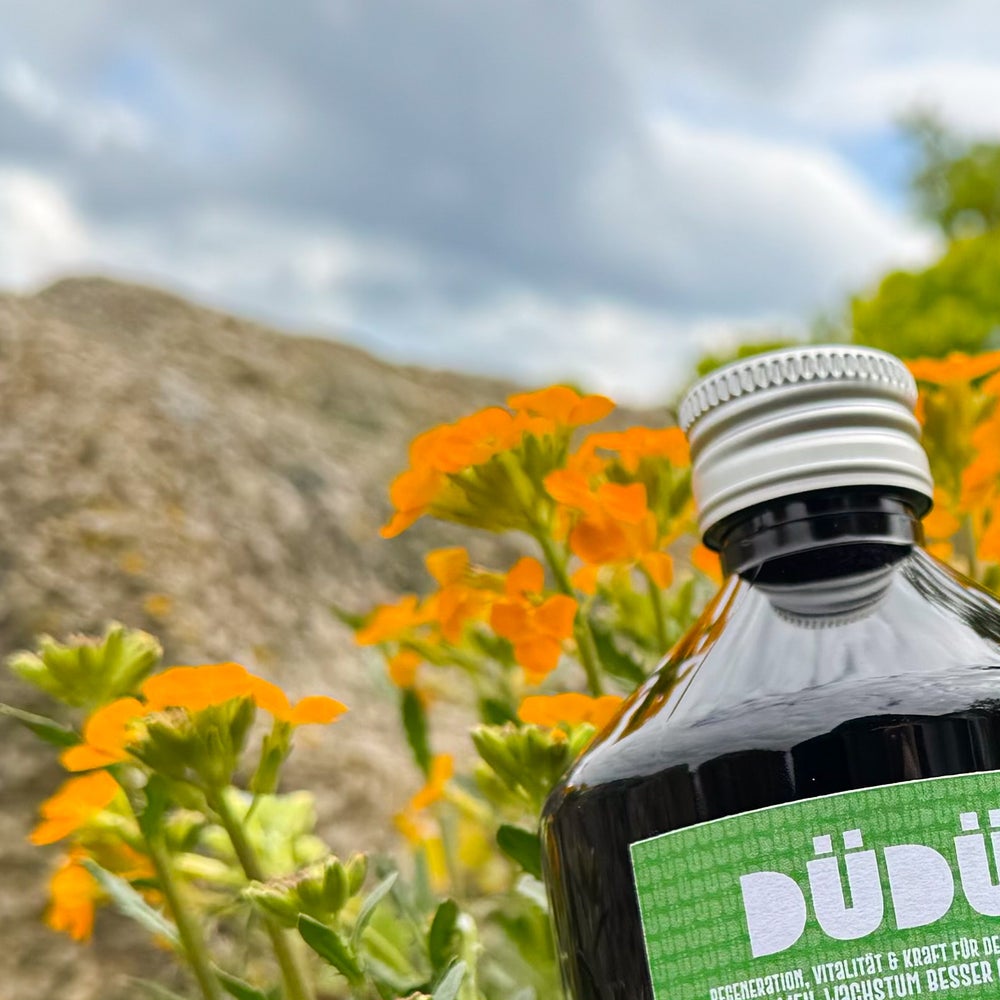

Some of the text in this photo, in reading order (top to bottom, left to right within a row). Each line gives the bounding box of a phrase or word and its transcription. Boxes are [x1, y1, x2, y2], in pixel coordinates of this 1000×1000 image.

[888, 951, 899, 970] &
[951, 937, 980, 960] FÜR
[926, 960, 993, 992] BESSER
